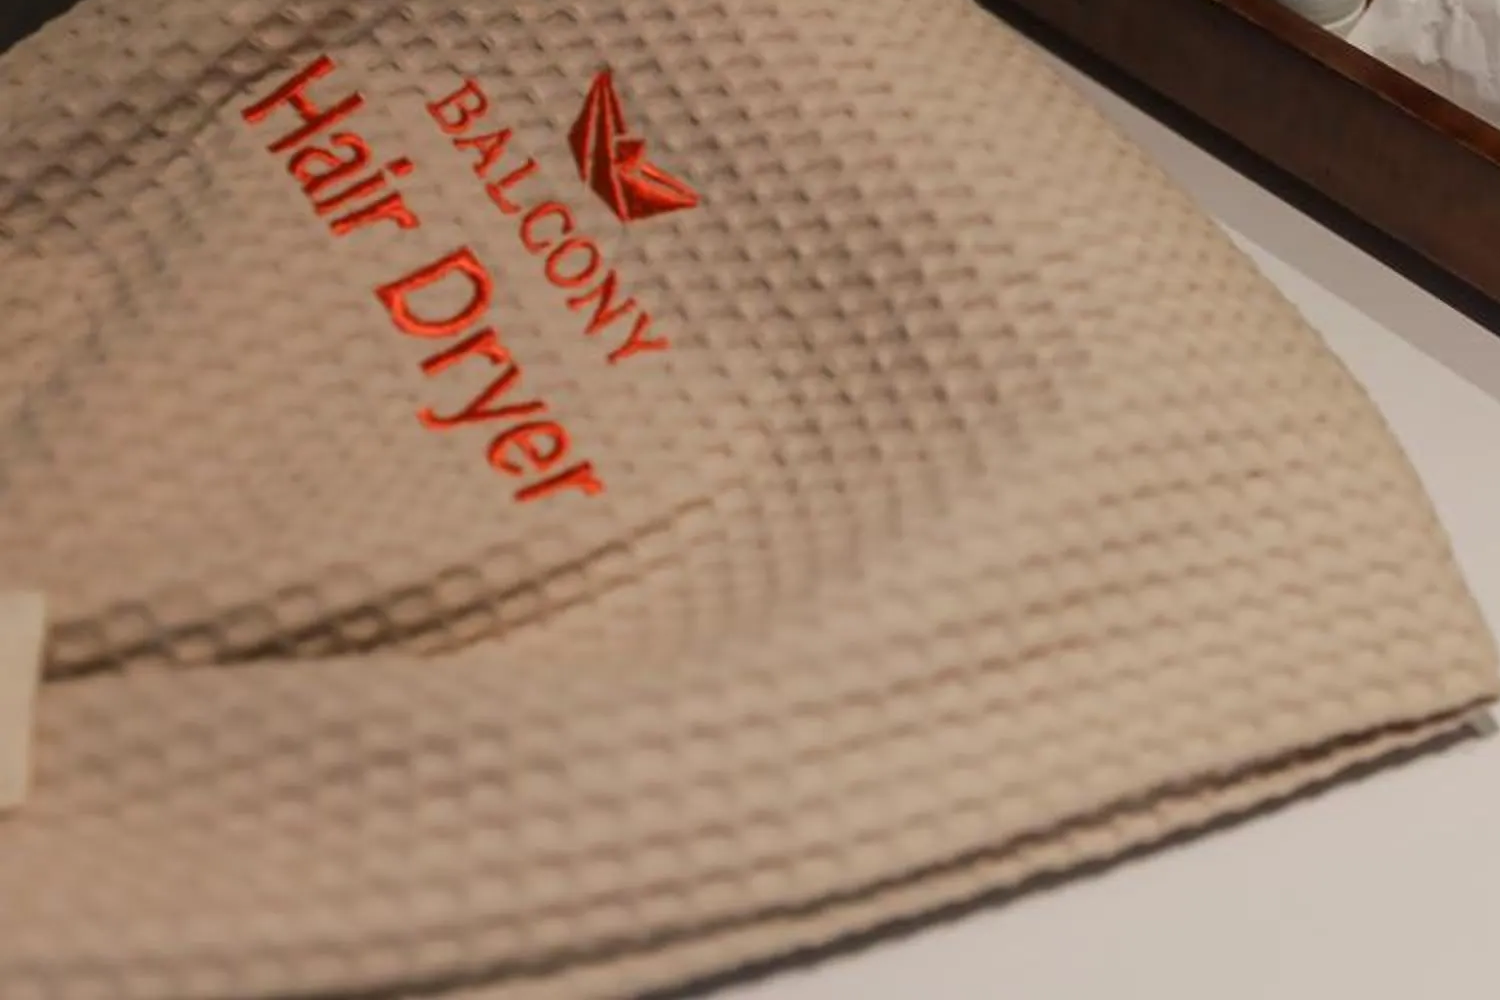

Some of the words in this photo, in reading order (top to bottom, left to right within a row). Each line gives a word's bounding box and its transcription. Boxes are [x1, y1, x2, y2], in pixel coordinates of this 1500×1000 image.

[241, 54, 420, 238] Hair
[424, 76, 671, 366] BALCONY
[374, 245, 608, 503] Dryer
